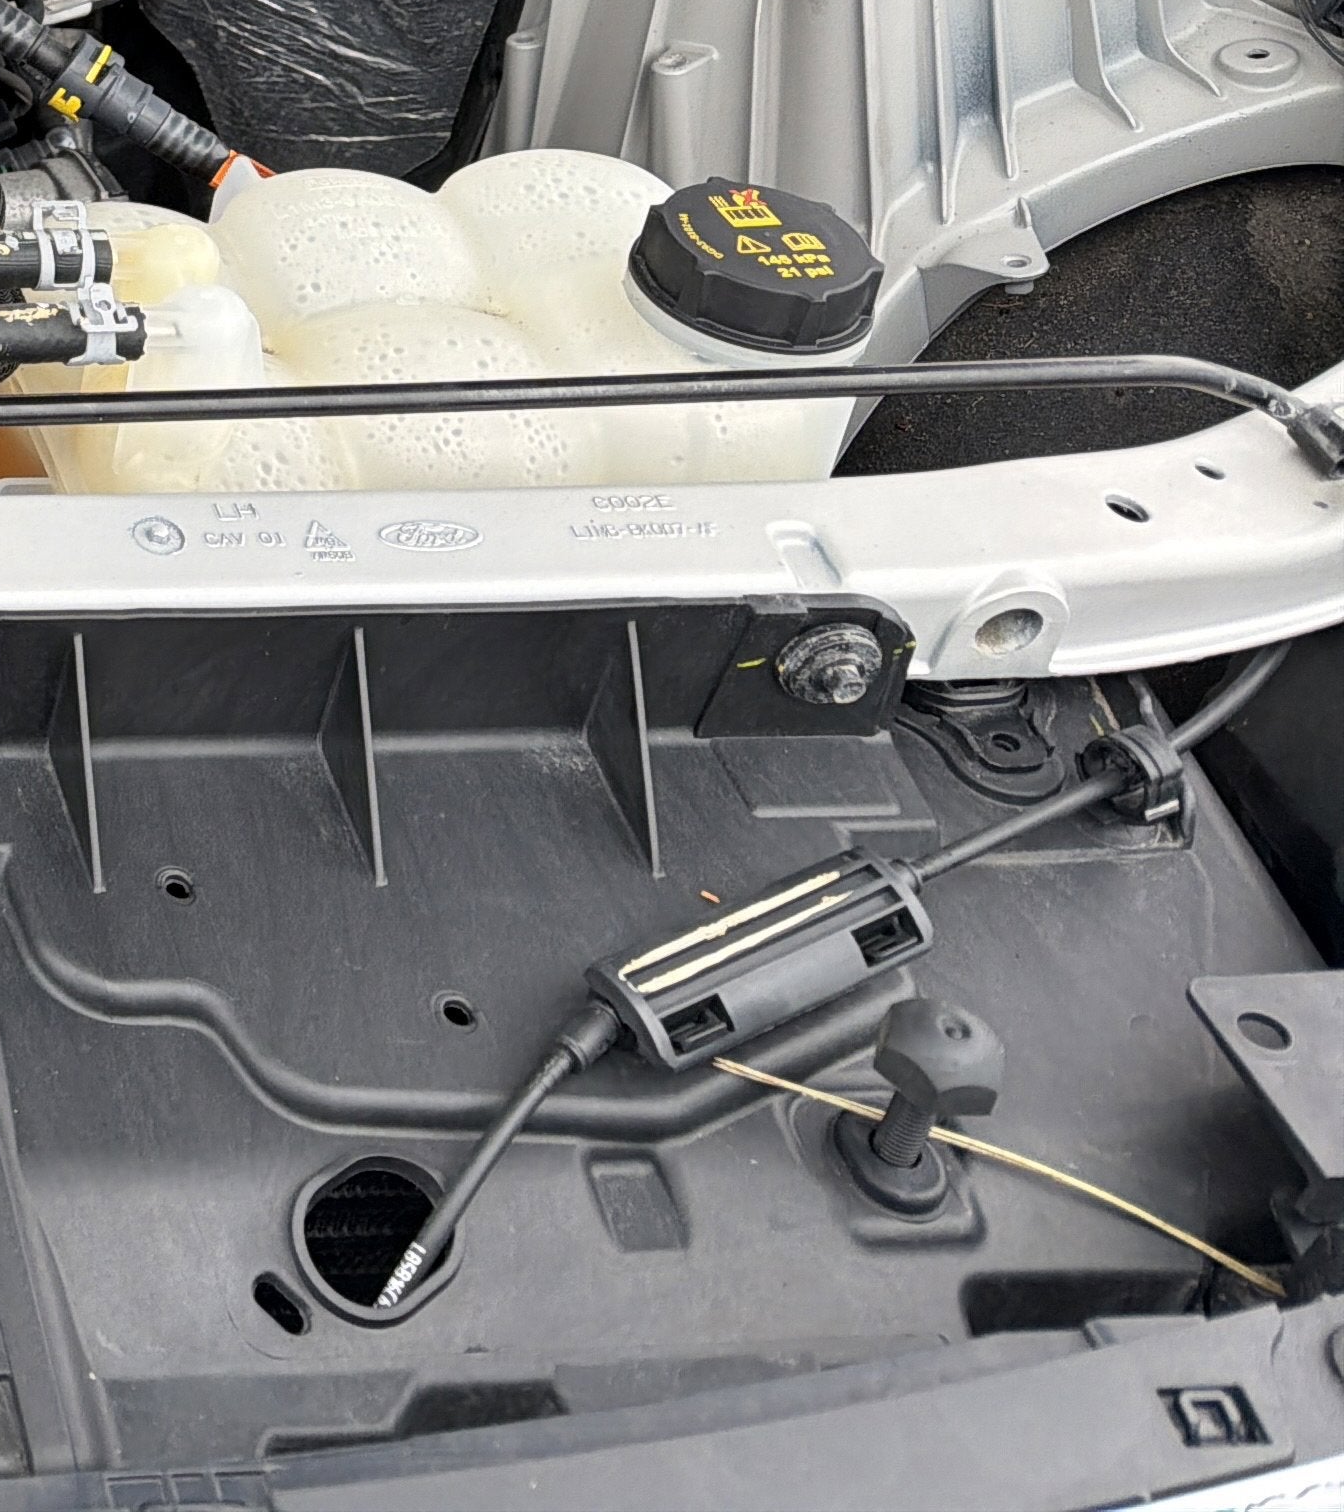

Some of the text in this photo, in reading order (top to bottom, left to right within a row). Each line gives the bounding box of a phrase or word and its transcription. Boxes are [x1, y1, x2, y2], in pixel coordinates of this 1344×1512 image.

[758, 253, 831, 266] 145 kPa
[777, 265, 835, 279] 21 psi
[213, 502, 259, 520] LH
[204, 531, 286, 547] CAV 01
